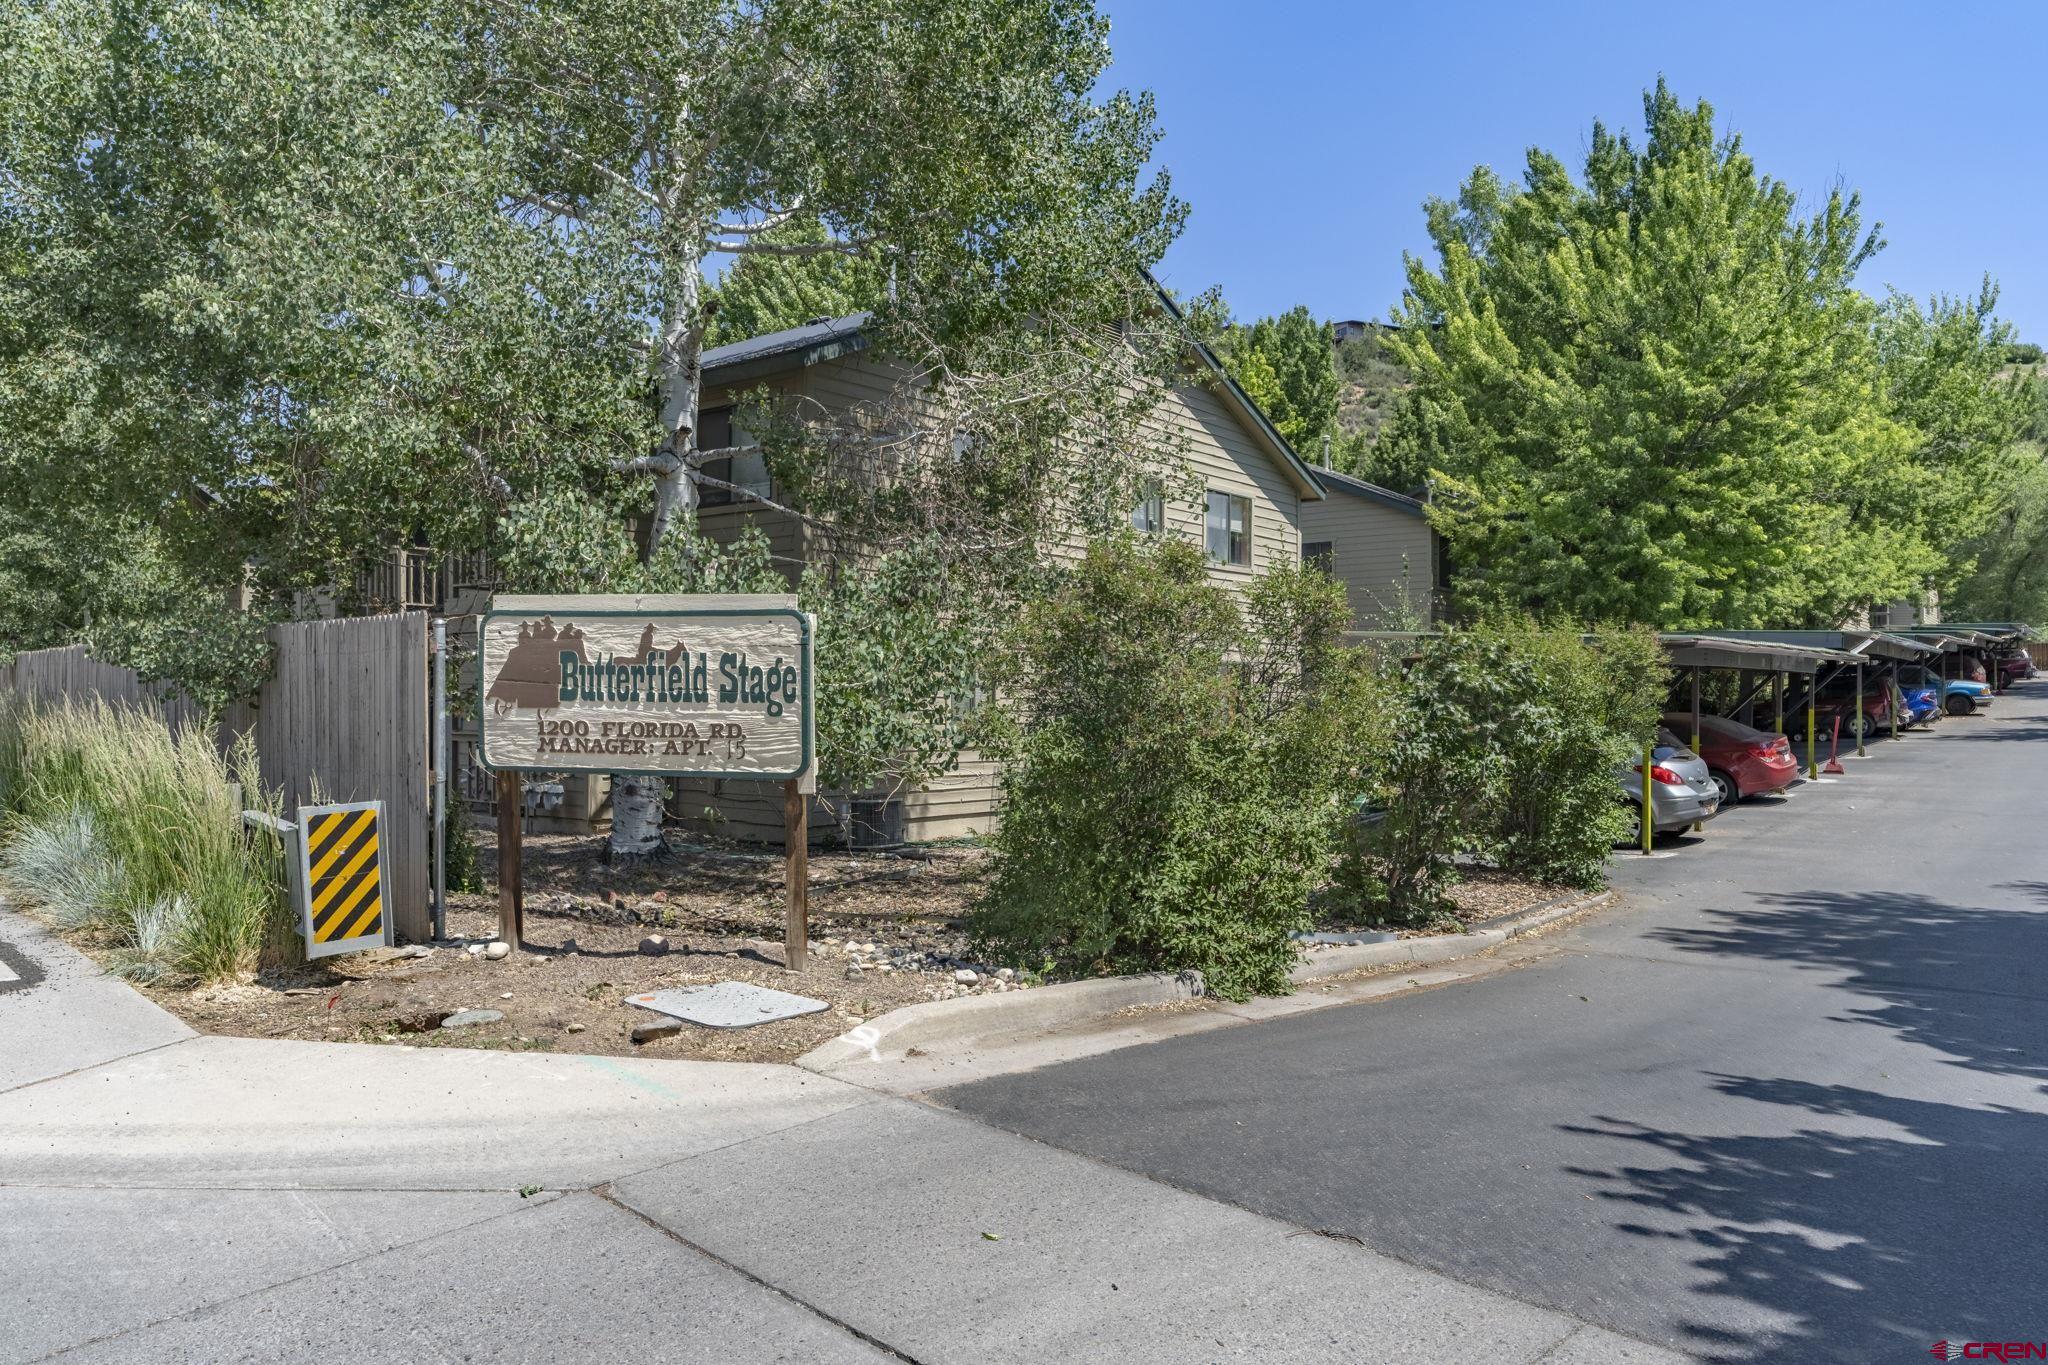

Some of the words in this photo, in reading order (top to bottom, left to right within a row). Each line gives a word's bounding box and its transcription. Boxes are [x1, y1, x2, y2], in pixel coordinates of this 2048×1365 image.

[559, 651, 708, 703] Butterfield
[719, 653, 797, 717] Stage
[538, 721, 589, 736] 1200
[602, 722, 698, 738] FLORIDA
[710, 723, 747, 739] RD.
[538, 738, 654, 754] MANAGER:
[662, 740, 712, 756] APT.
[727, 740, 746, 759] 15
